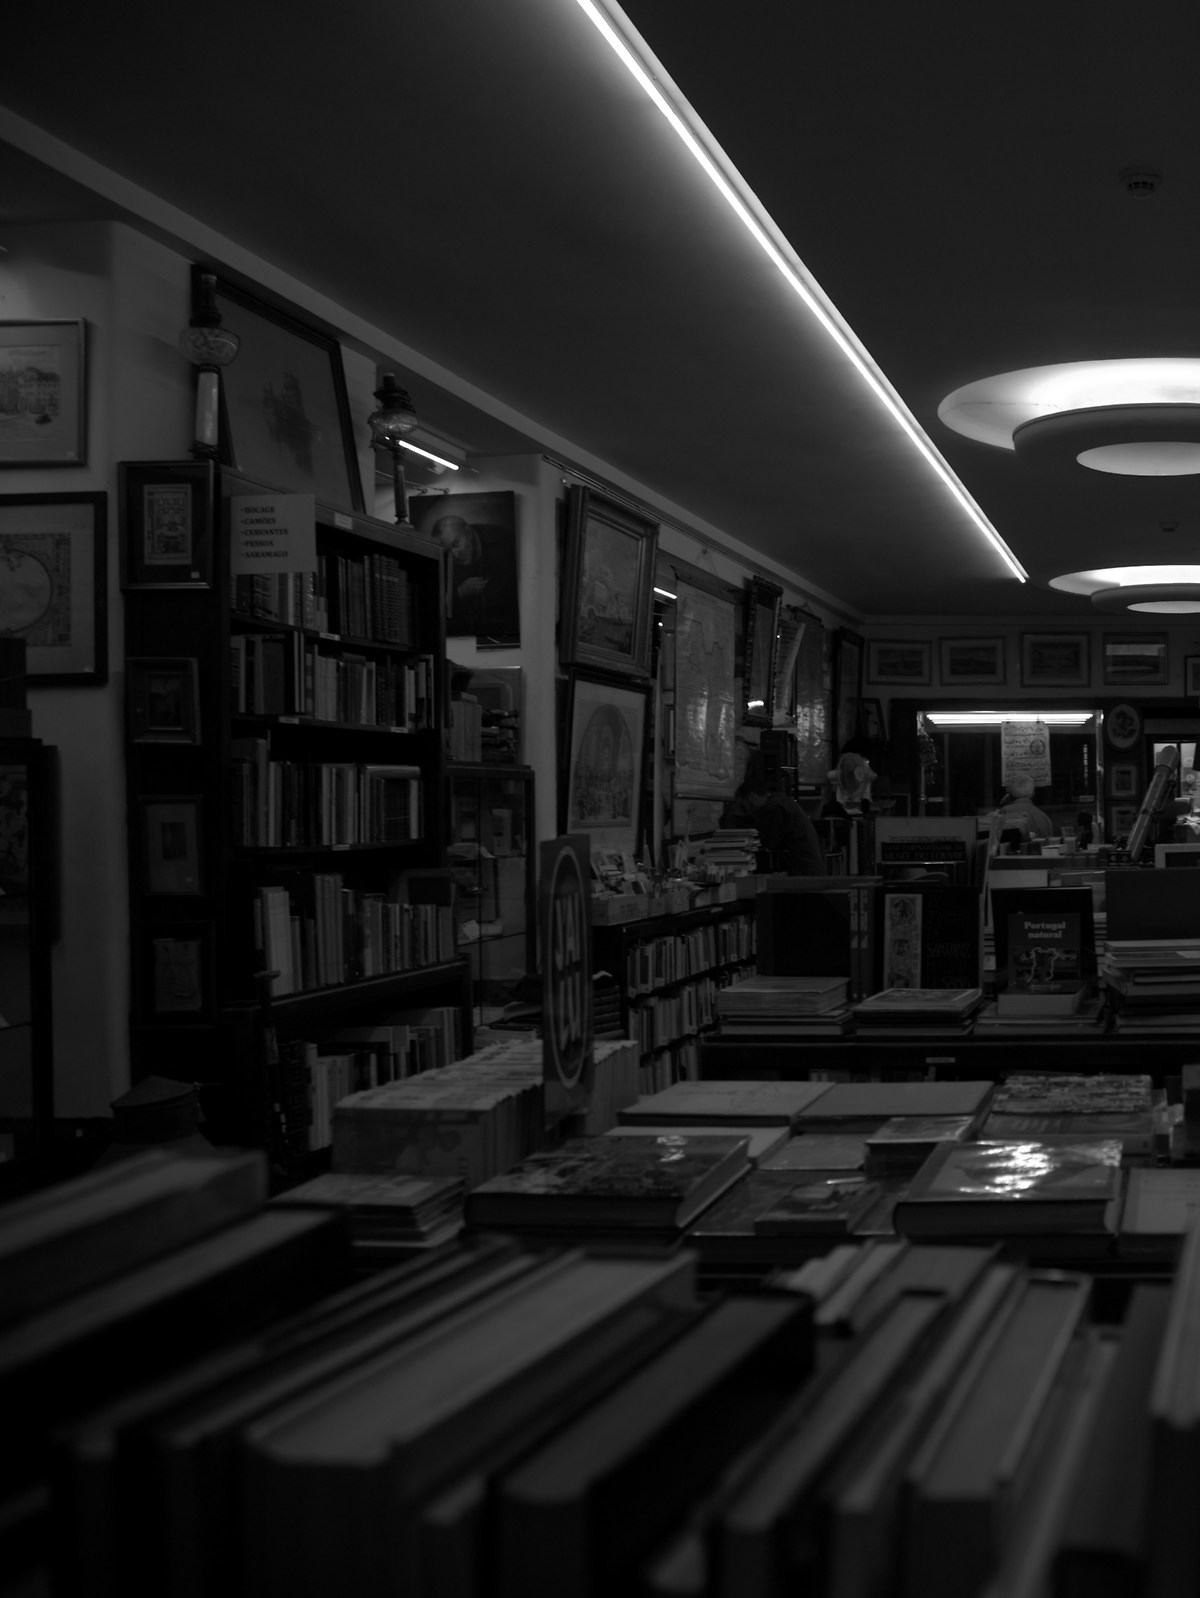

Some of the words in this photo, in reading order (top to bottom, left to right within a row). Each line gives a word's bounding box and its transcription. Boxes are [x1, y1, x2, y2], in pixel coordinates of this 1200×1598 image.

[244, 506, 275, 514] BOCAGE
[244, 516, 276, 525] CAMÕES
[244, 528, 289, 536] CERVANTES
[245, 540, 274, 548] PESSOA
[245, 550, 288, 559] SARAMAGO
[1024, 921, 1066, 931] Portugal
[1027, 930, 1063, 938] natural
